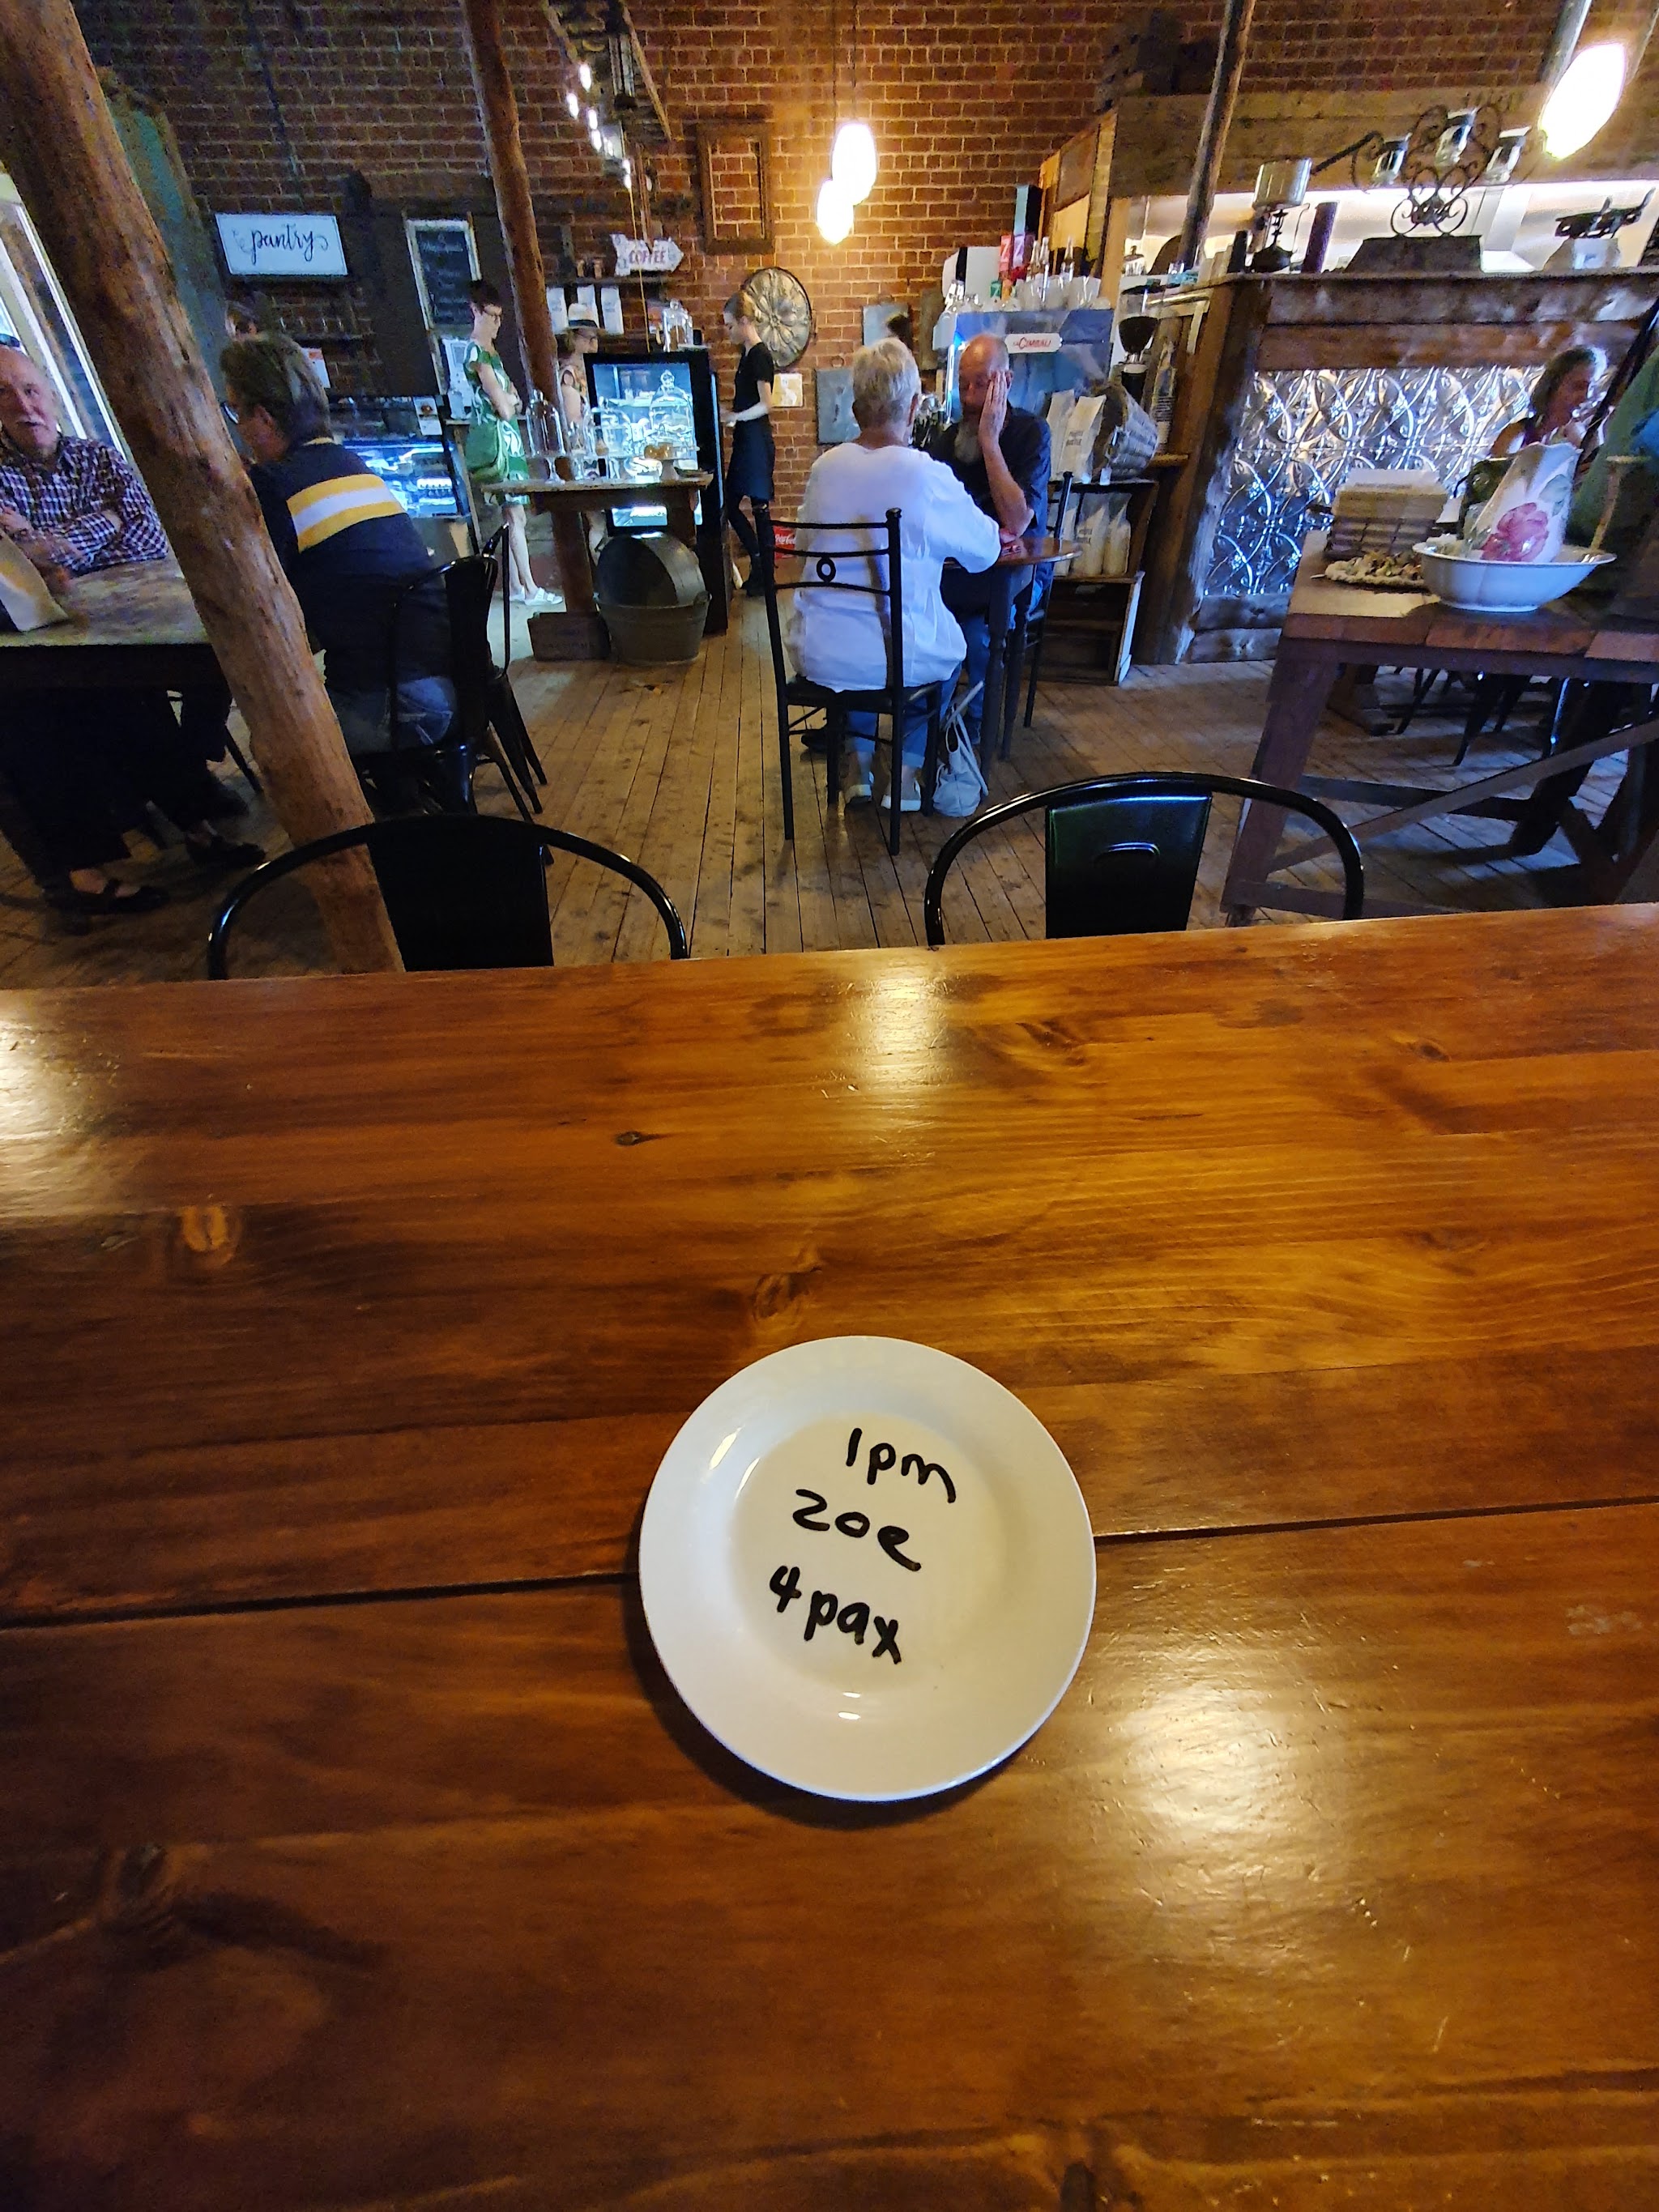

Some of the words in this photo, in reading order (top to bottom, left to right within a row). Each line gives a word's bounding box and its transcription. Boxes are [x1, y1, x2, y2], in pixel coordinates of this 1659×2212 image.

[245, 224, 326, 266] pantry
[629, 249, 667, 265] COFFEE
[846, 1428, 956, 1503] 1pm
